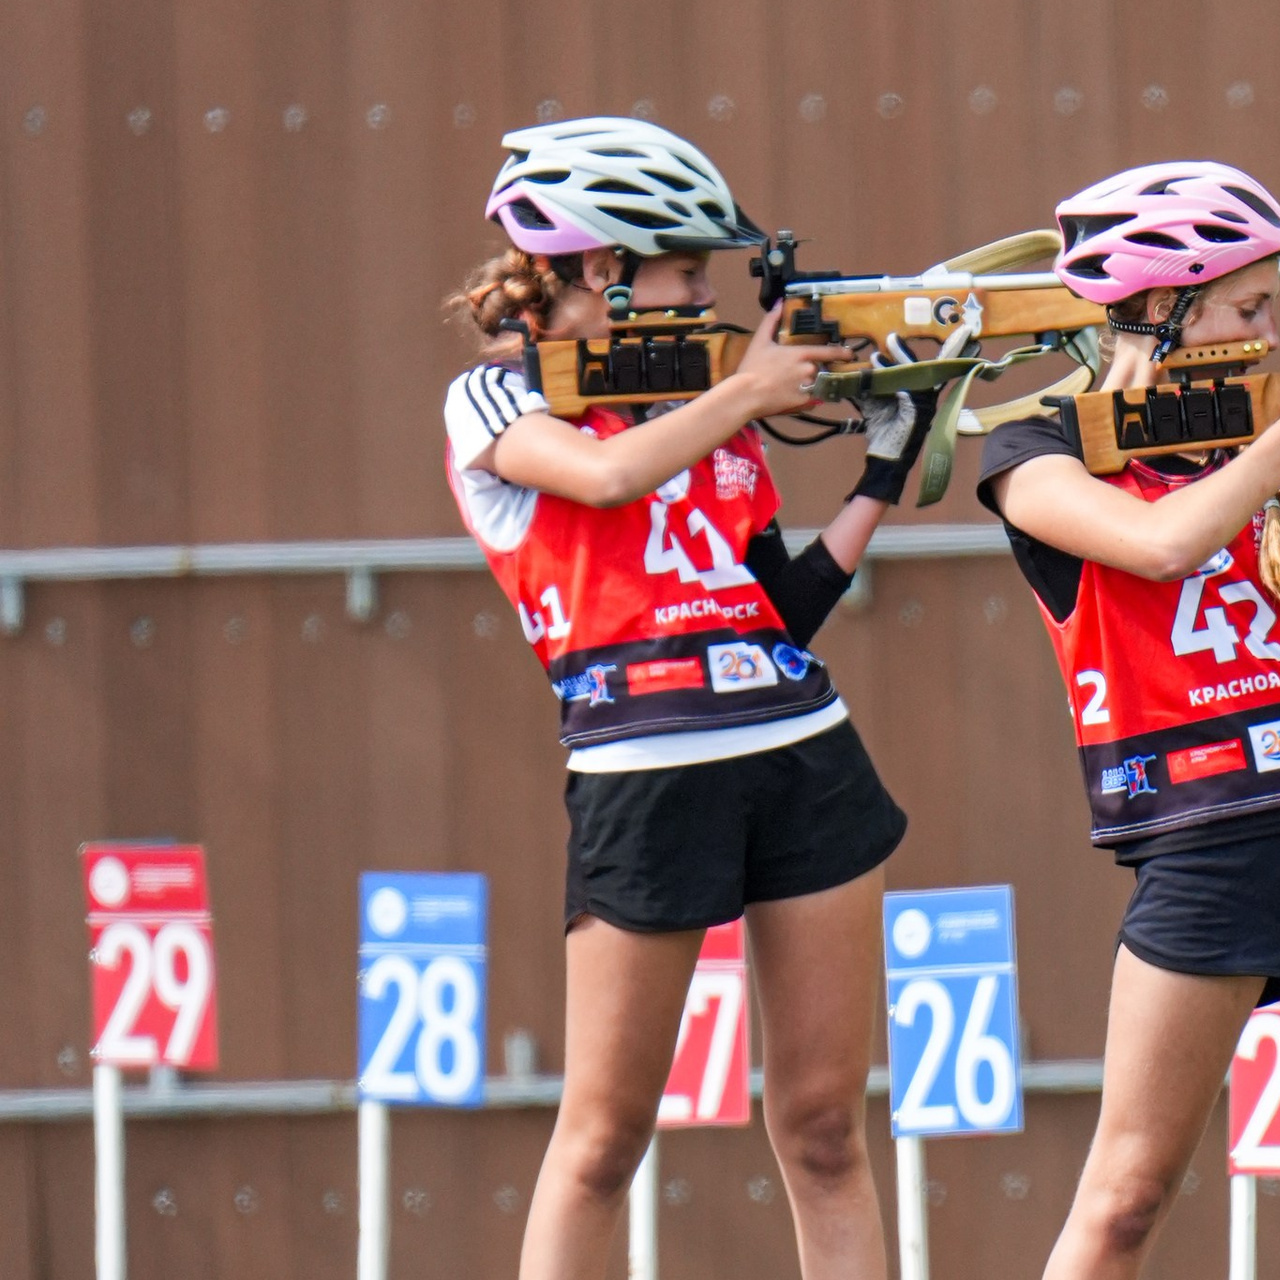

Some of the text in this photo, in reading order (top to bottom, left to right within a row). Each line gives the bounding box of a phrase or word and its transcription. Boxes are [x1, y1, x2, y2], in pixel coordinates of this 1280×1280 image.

[643, 502, 757, 591] 41
[1068, 669, 1110, 726] 2
[96, 921, 213, 1066] 29
[362, 954, 480, 1102] 28
[896, 976, 1015, 1130] 26
